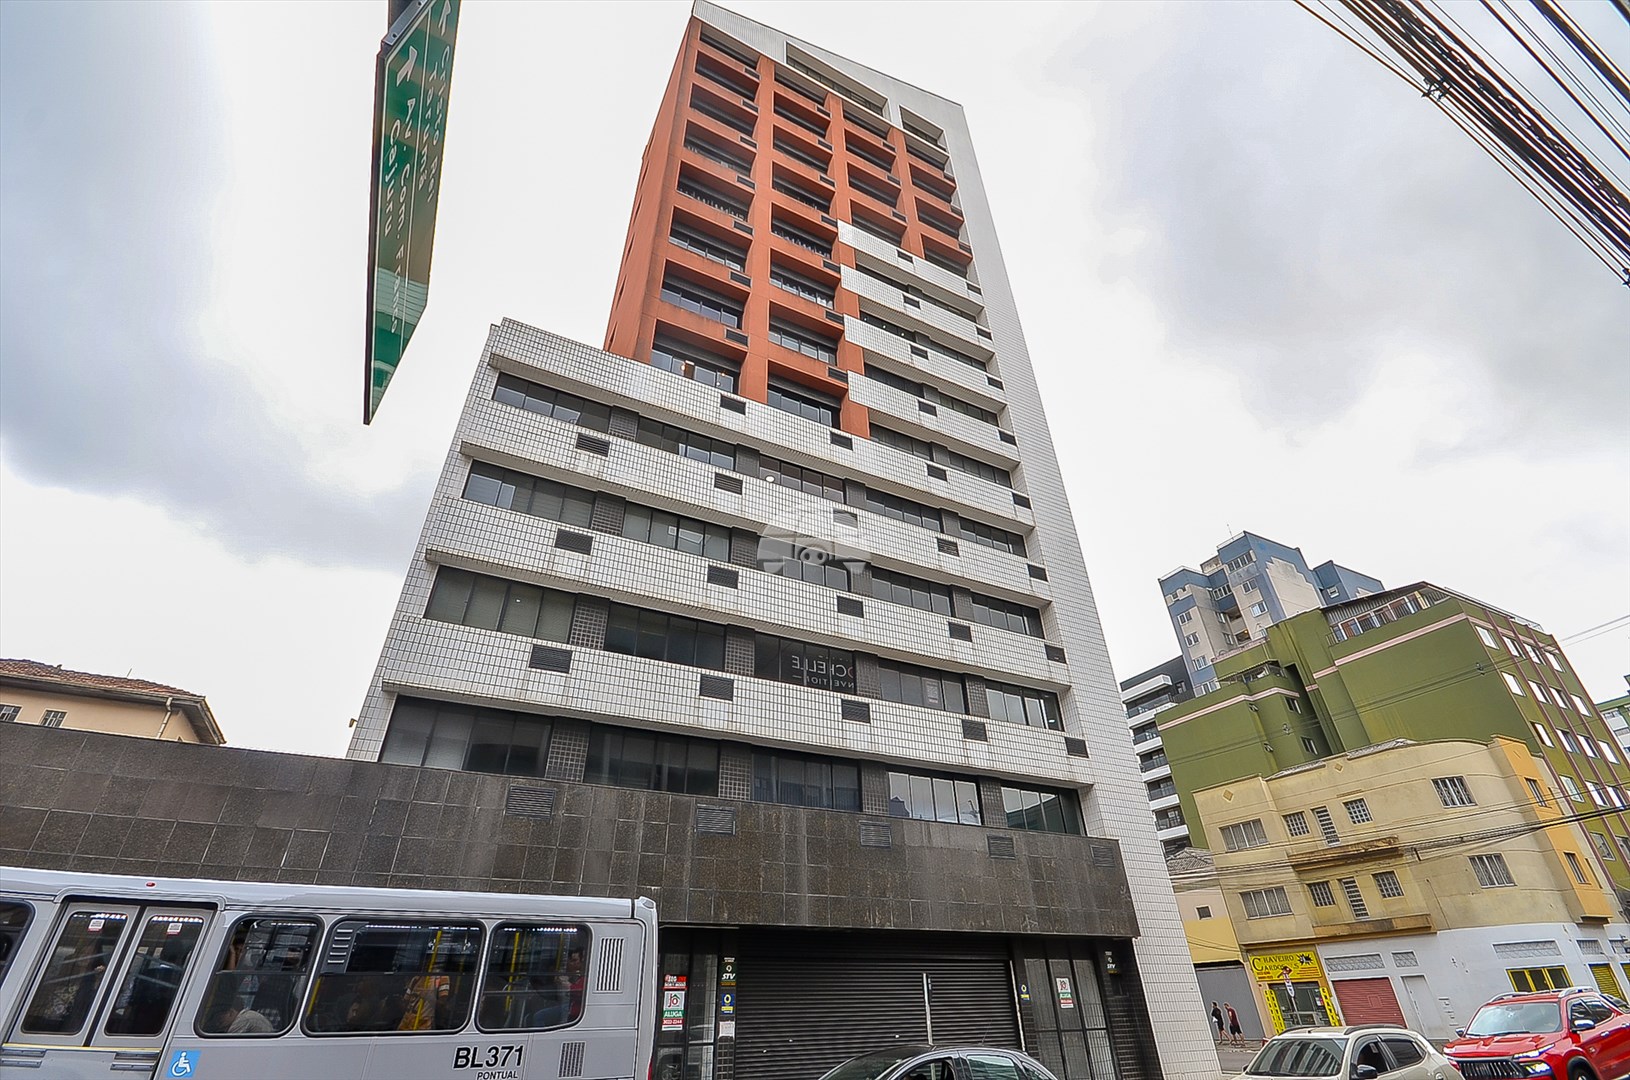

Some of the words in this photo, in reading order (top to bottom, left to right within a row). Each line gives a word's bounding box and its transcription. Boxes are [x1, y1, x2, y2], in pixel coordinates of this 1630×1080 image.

[403, 97, 417, 152] Av.
[418, 61, 438, 191] Tarumã
[432, 45, 451, 146] Cristo
[383, 119, 402, 238] Cajuru
[396, 162, 411, 240] Com.
[427, 155, 439, 203] Rei
[391, 243, 405, 334] Franco
[1252, 955, 1294, 972] CHAVEIRO
[453, 1045, 524, 1069] BL371
[476, 1071, 518, 1080] PONTUAL
